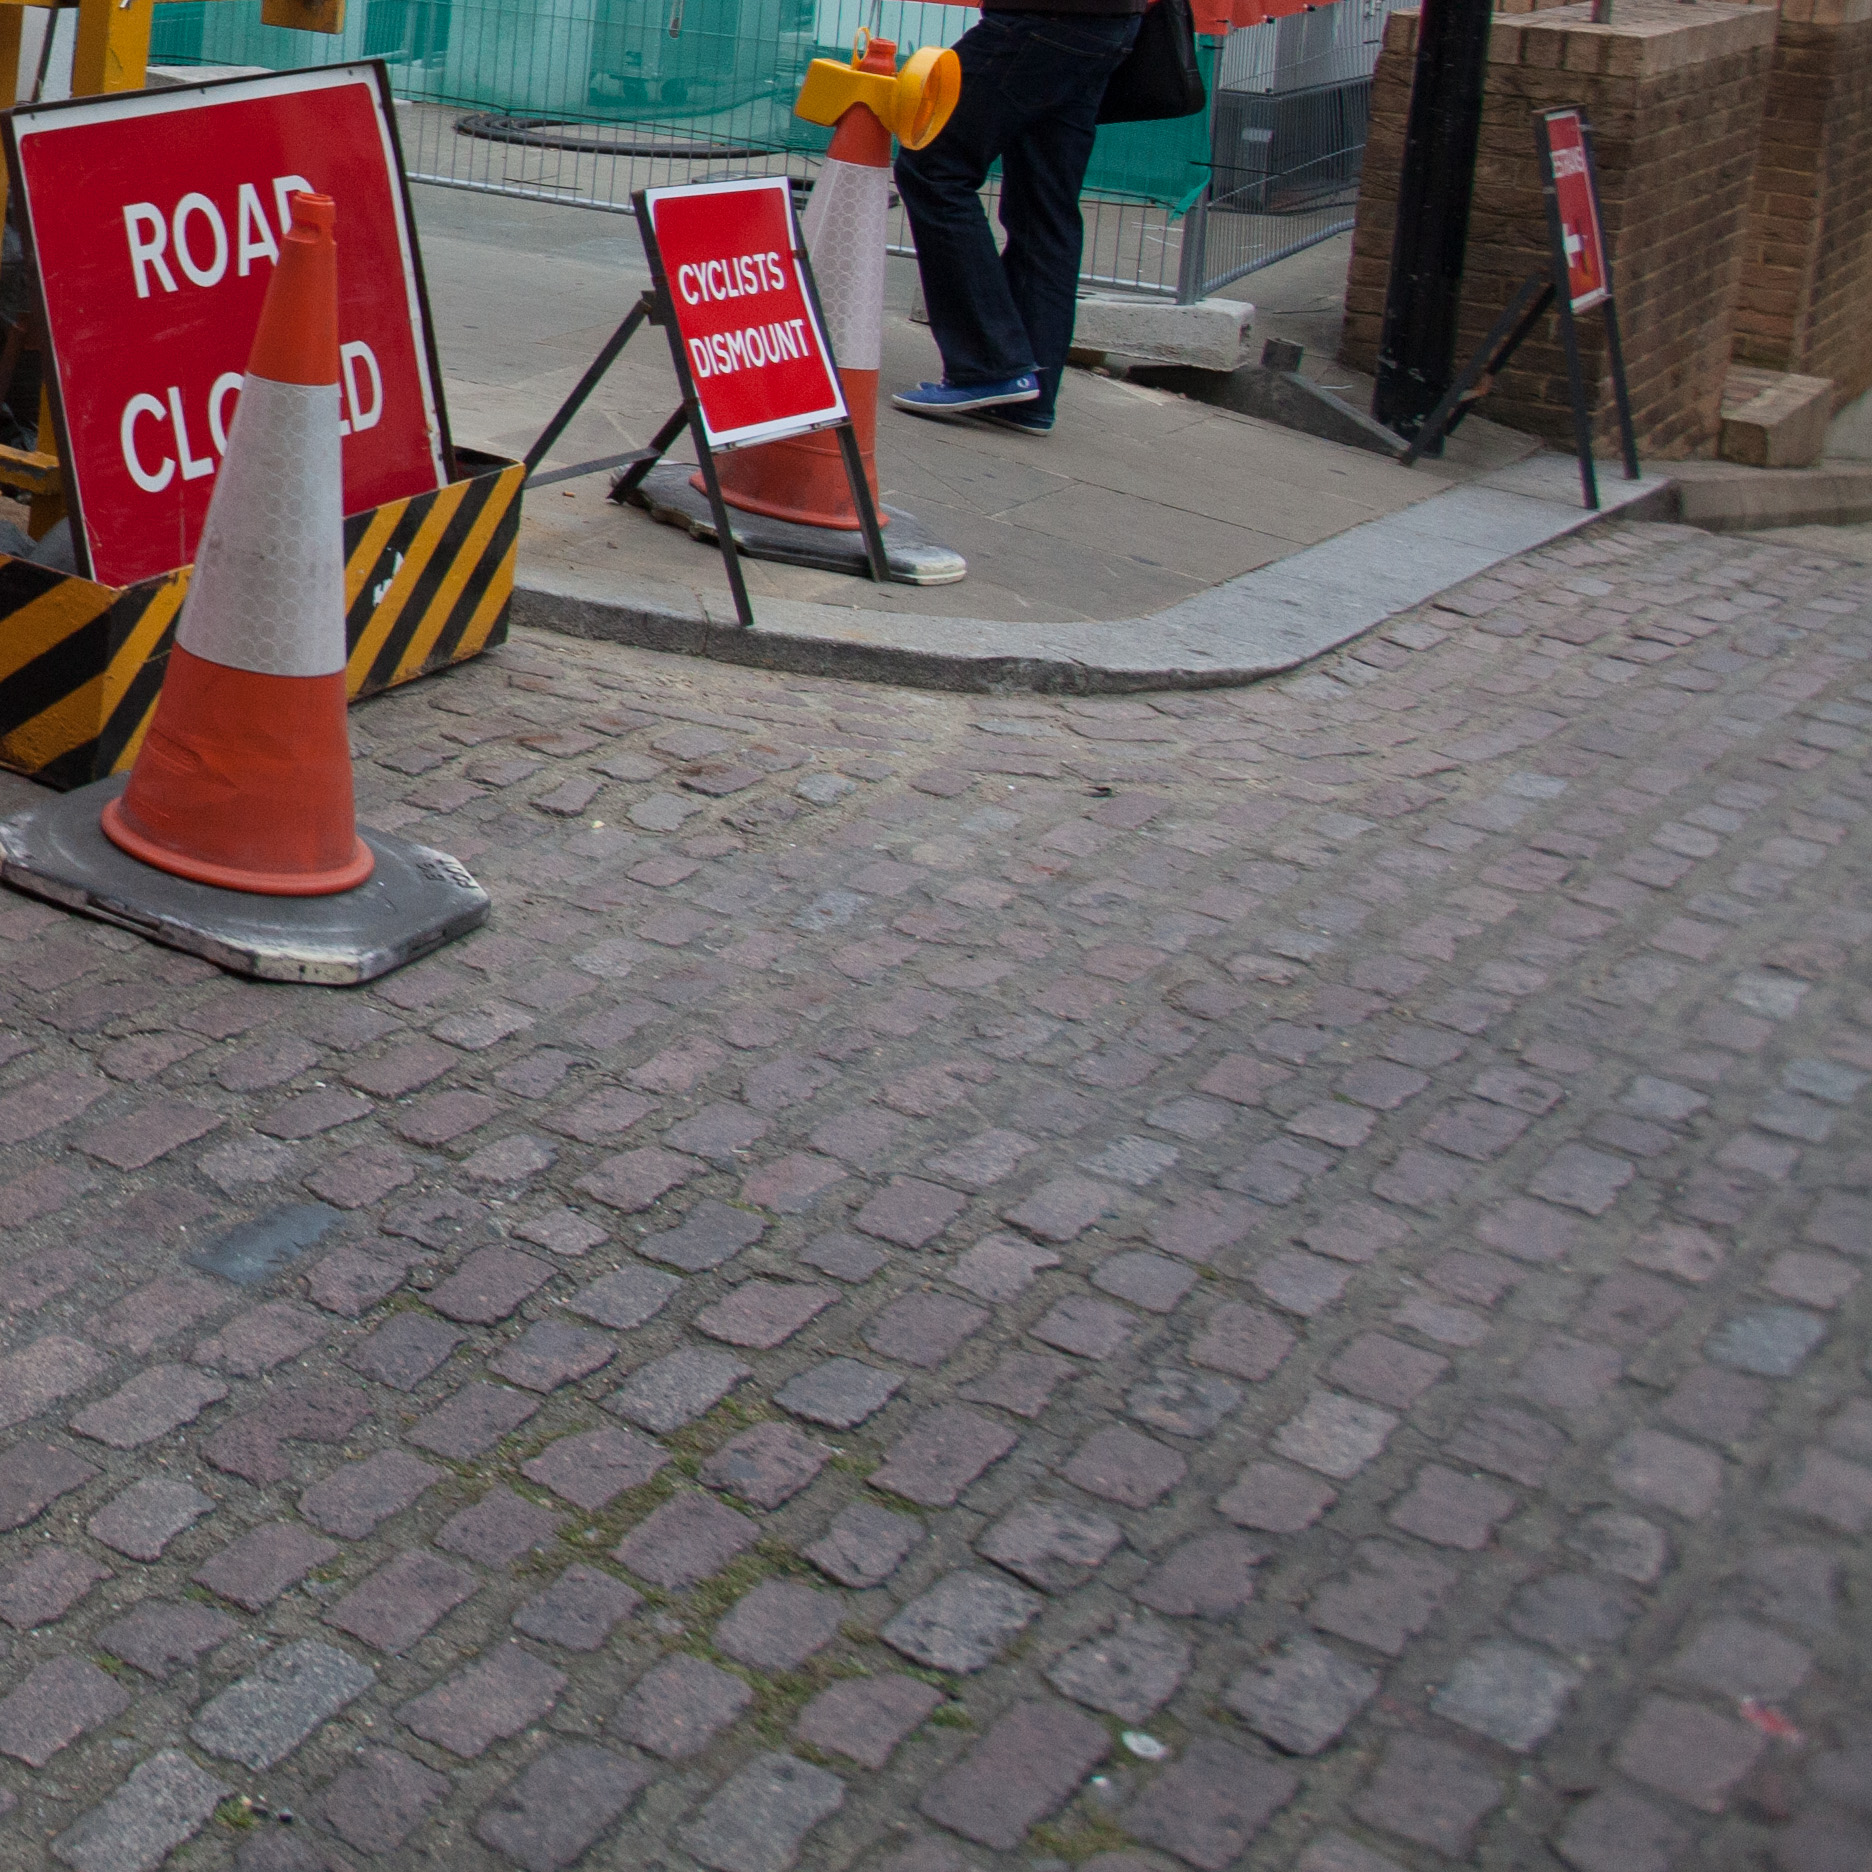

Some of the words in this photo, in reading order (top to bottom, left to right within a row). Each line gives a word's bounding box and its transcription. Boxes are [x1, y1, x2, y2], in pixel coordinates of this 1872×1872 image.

[678, 251, 786, 306] CYCLISTS
[688, 318, 809, 378] DISMOUNT
[120, 339, 384, 494] CLD
